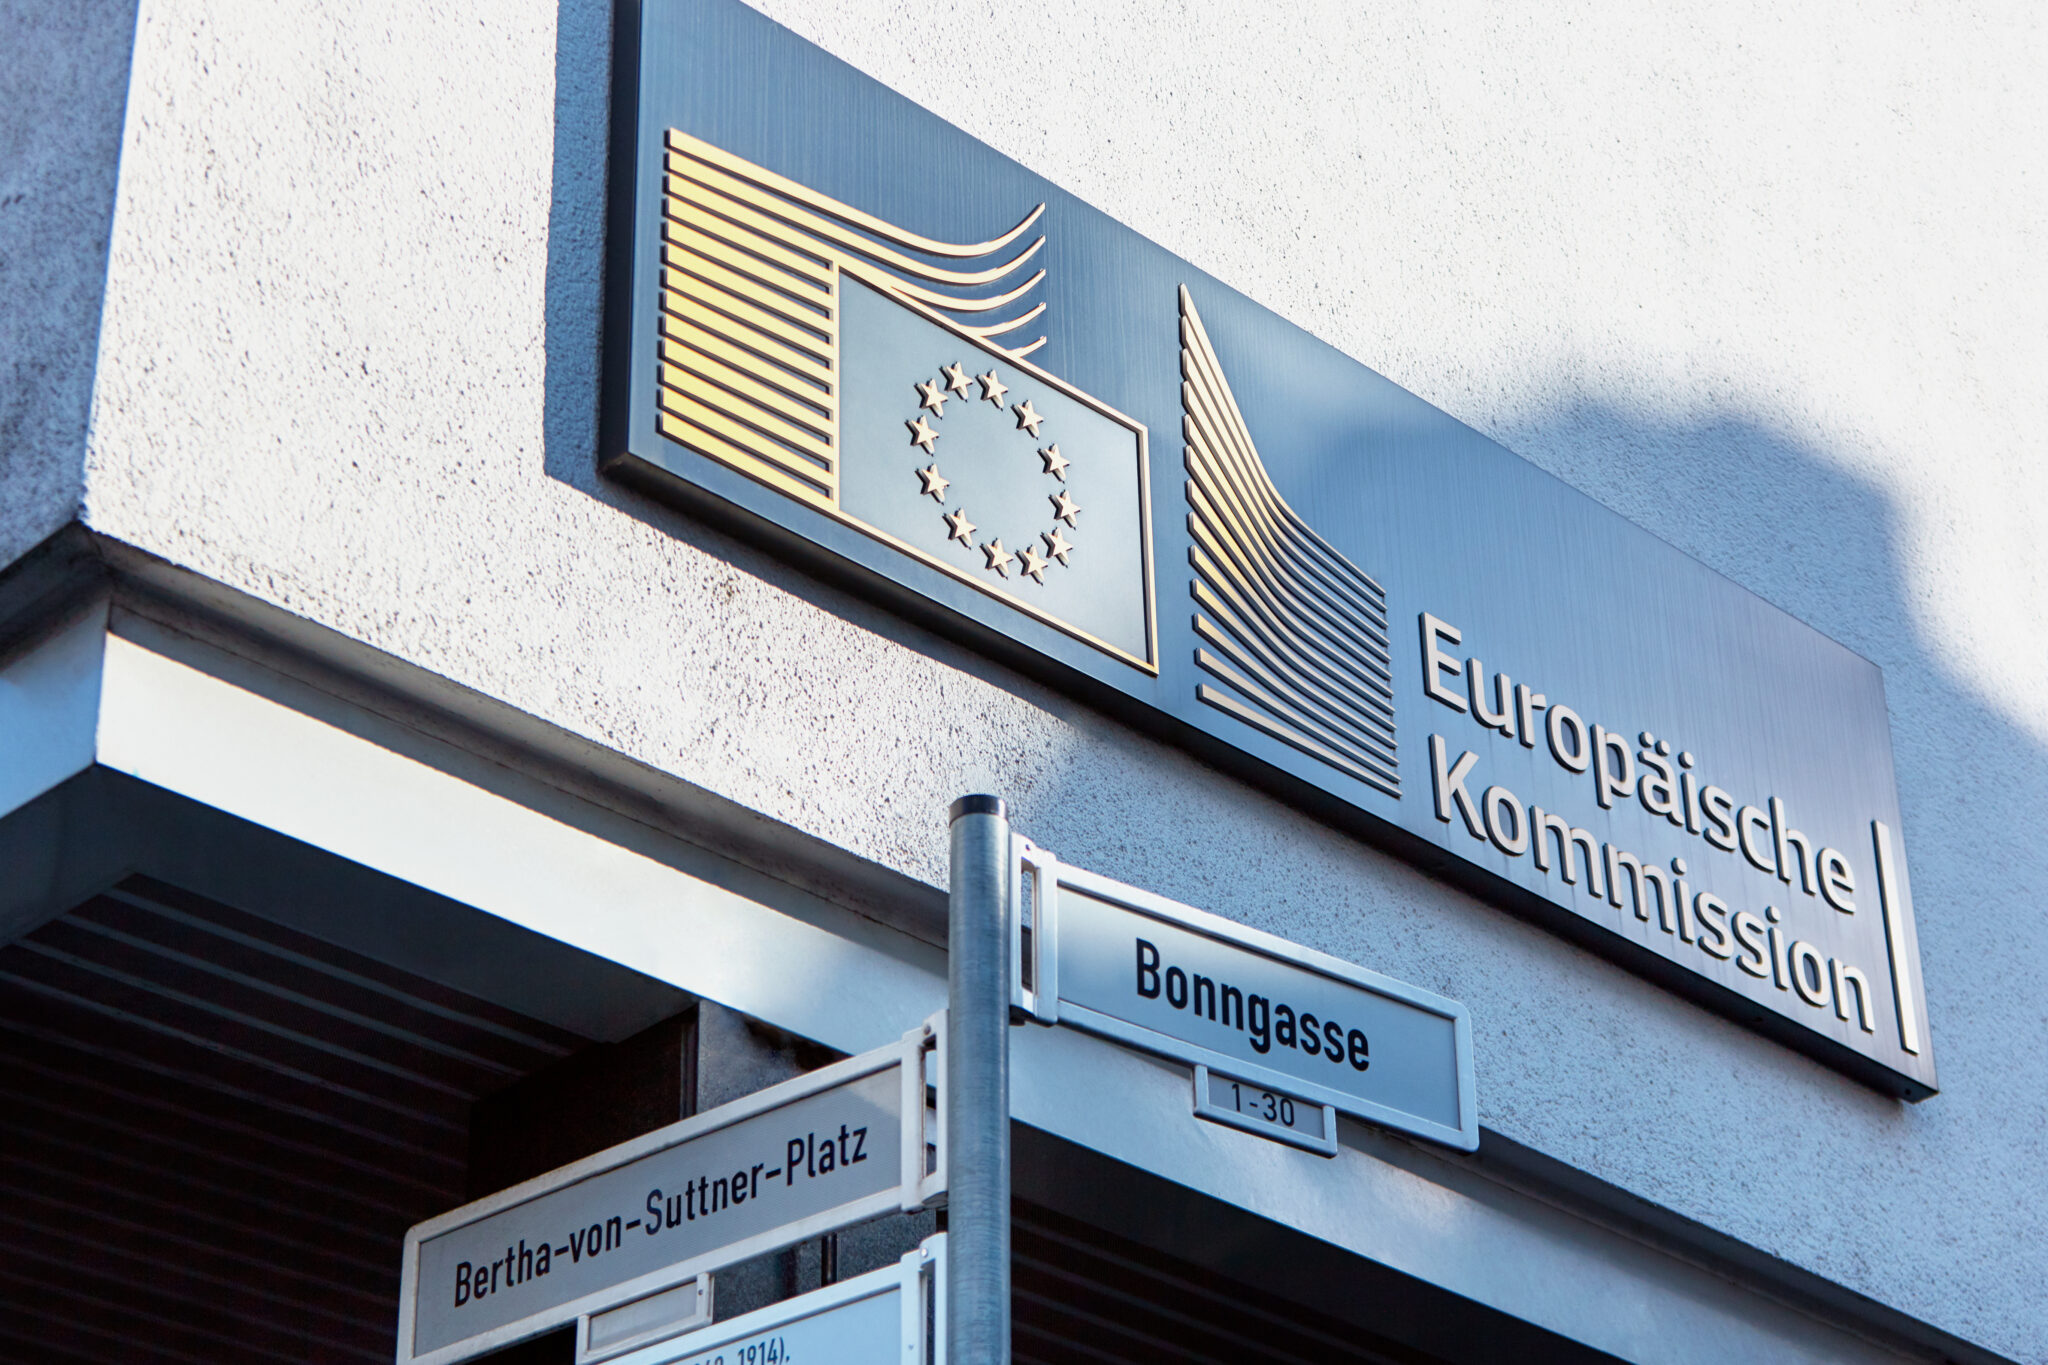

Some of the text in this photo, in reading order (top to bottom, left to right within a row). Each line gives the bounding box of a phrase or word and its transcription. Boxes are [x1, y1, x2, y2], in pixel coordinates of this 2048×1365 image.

[1418, 611, 1857, 916] Europäische
[1429, 733, 1875, 1034] Kommission
[1136, 937, 1371, 1072] Bonngasse
[1231, 1083, 1295, 1128] 1-30
[454, 1124, 869, 1308] Bertha-von-Suttner-Platz
